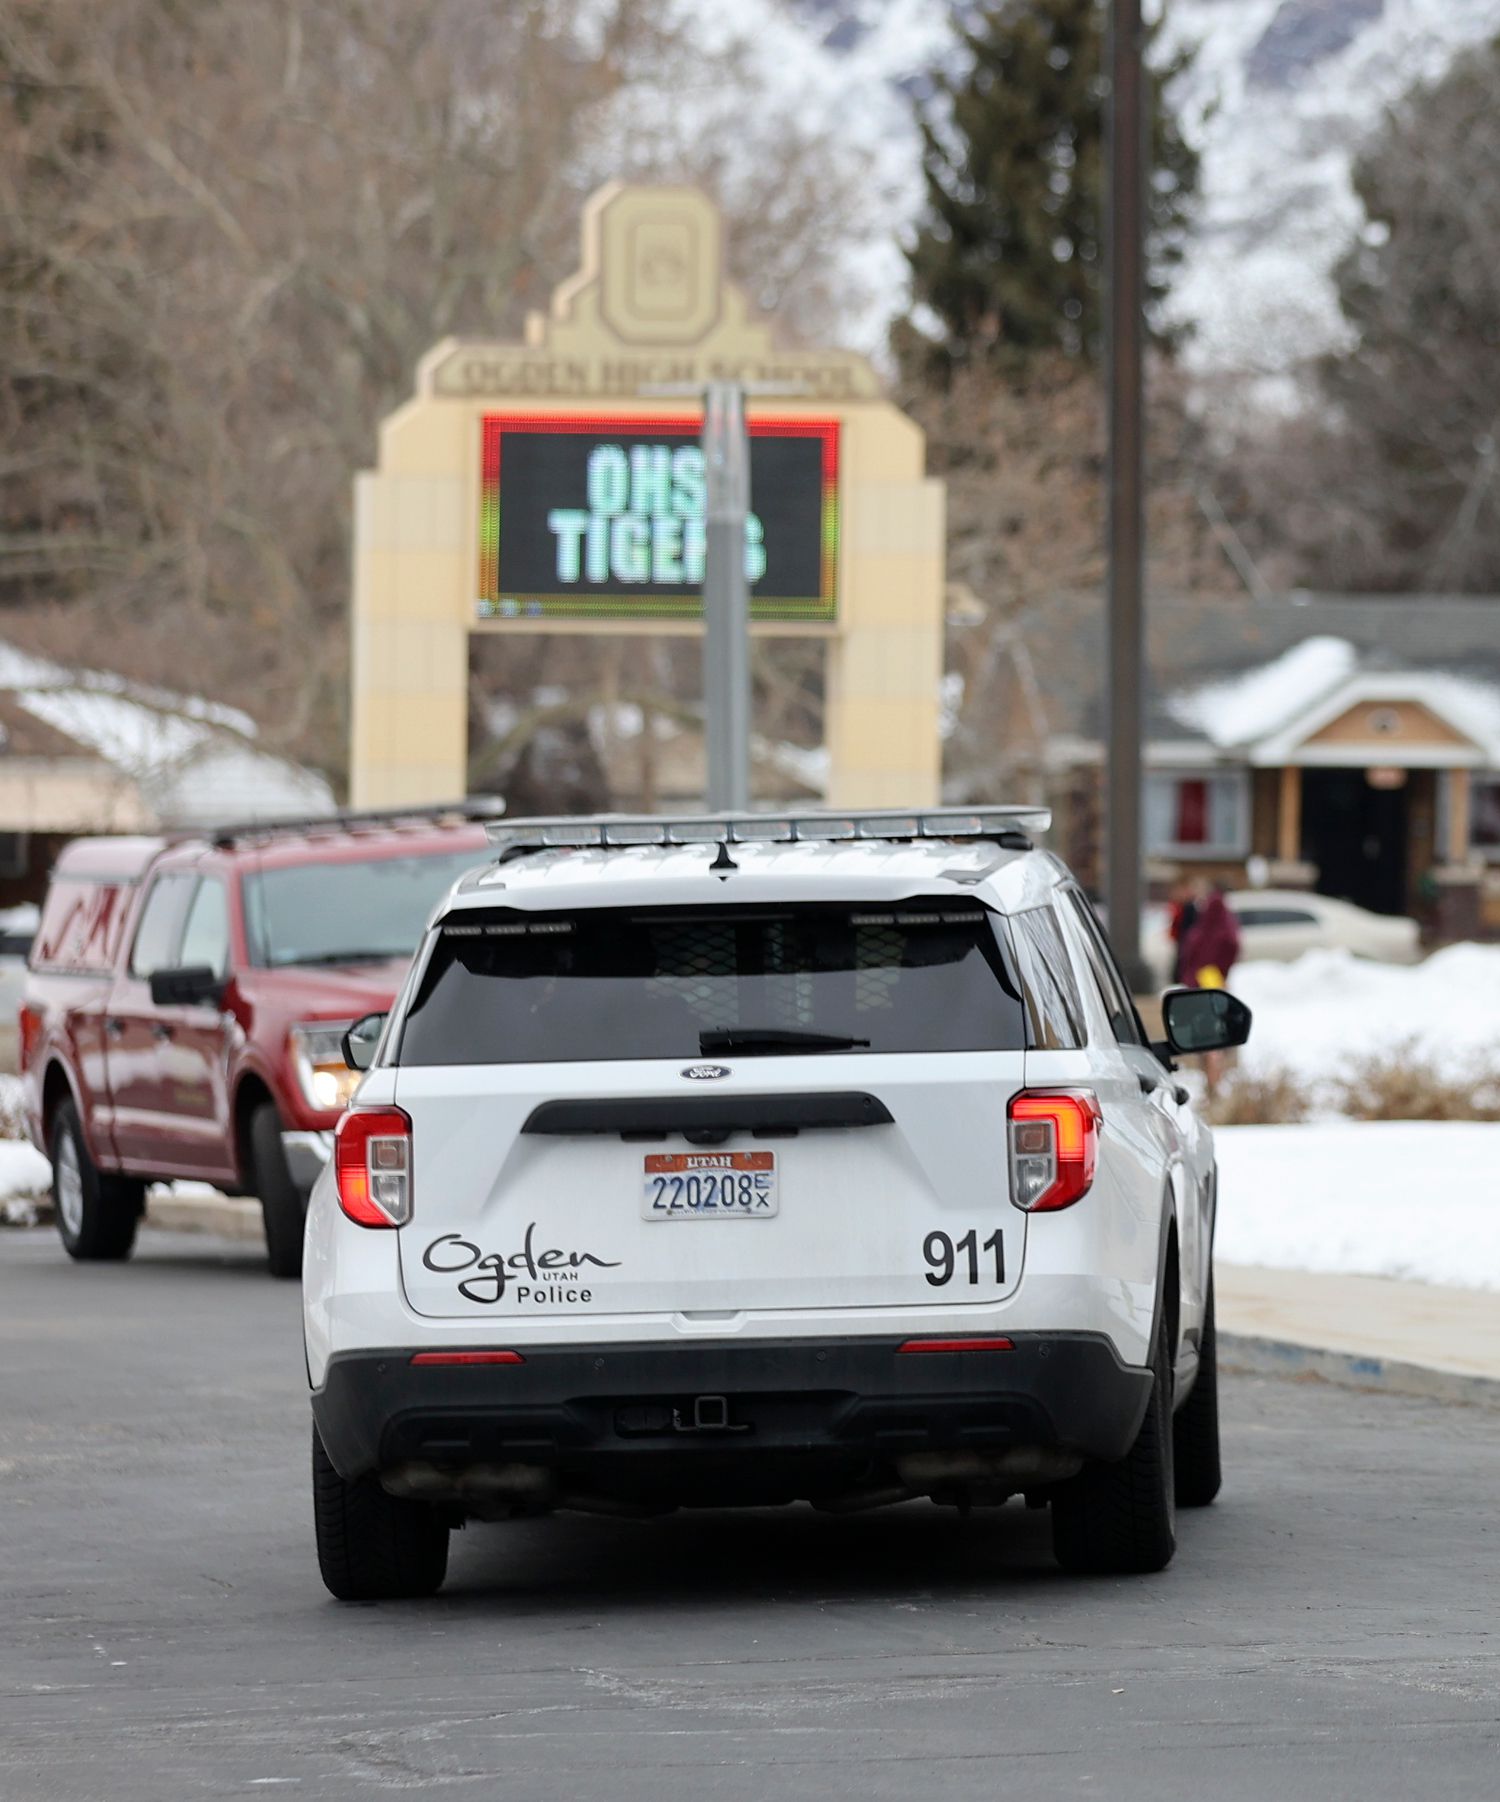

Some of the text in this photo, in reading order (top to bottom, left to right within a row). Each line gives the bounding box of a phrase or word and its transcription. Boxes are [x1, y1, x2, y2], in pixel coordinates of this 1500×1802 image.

[586, 443, 708, 517] OHS
[687, 1155, 733, 1168] UTAH
[653, 1174, 752, 1209] 220208
[422, 1222, 623, 1304] Ogden
[923, 1229, 1005, 1287] 911
[543, 1272, 579, 1281] UTAH
[517, 1286, 593, 1304] Police
